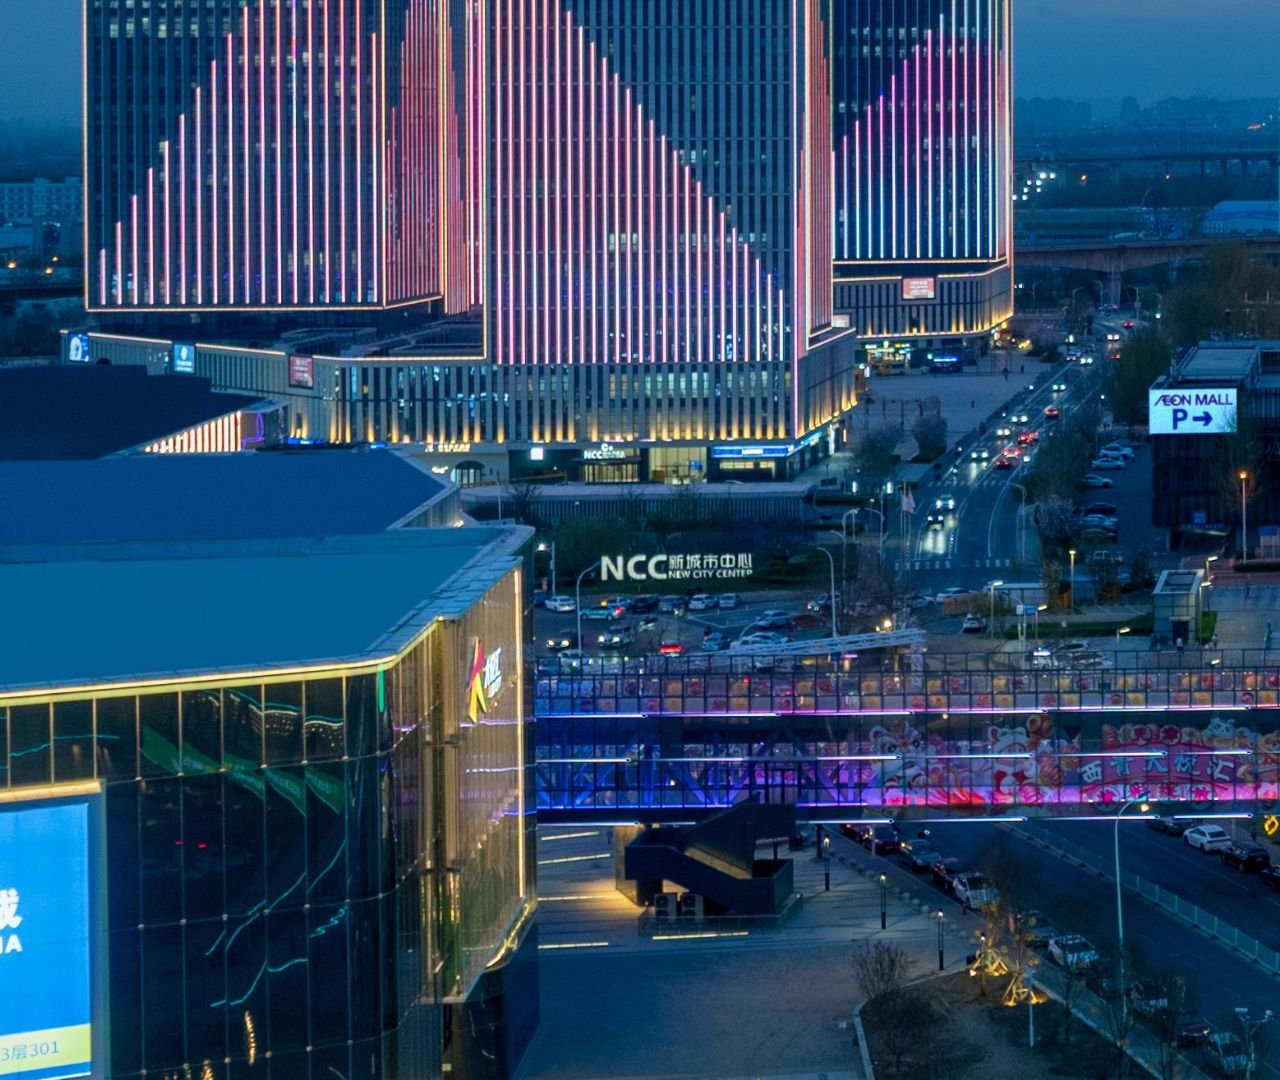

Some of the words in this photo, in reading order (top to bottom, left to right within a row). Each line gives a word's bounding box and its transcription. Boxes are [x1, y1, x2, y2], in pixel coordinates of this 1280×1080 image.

[1195, 394, 1233, 406] MALL
[1172, 409, 1188, 430] P
[601, 554, 668, 581] NCC
[669, 553, 753, 570] 新城市中心
[669, 570, 691, 579] NEW
[693, 570, 715, 579] CITY
